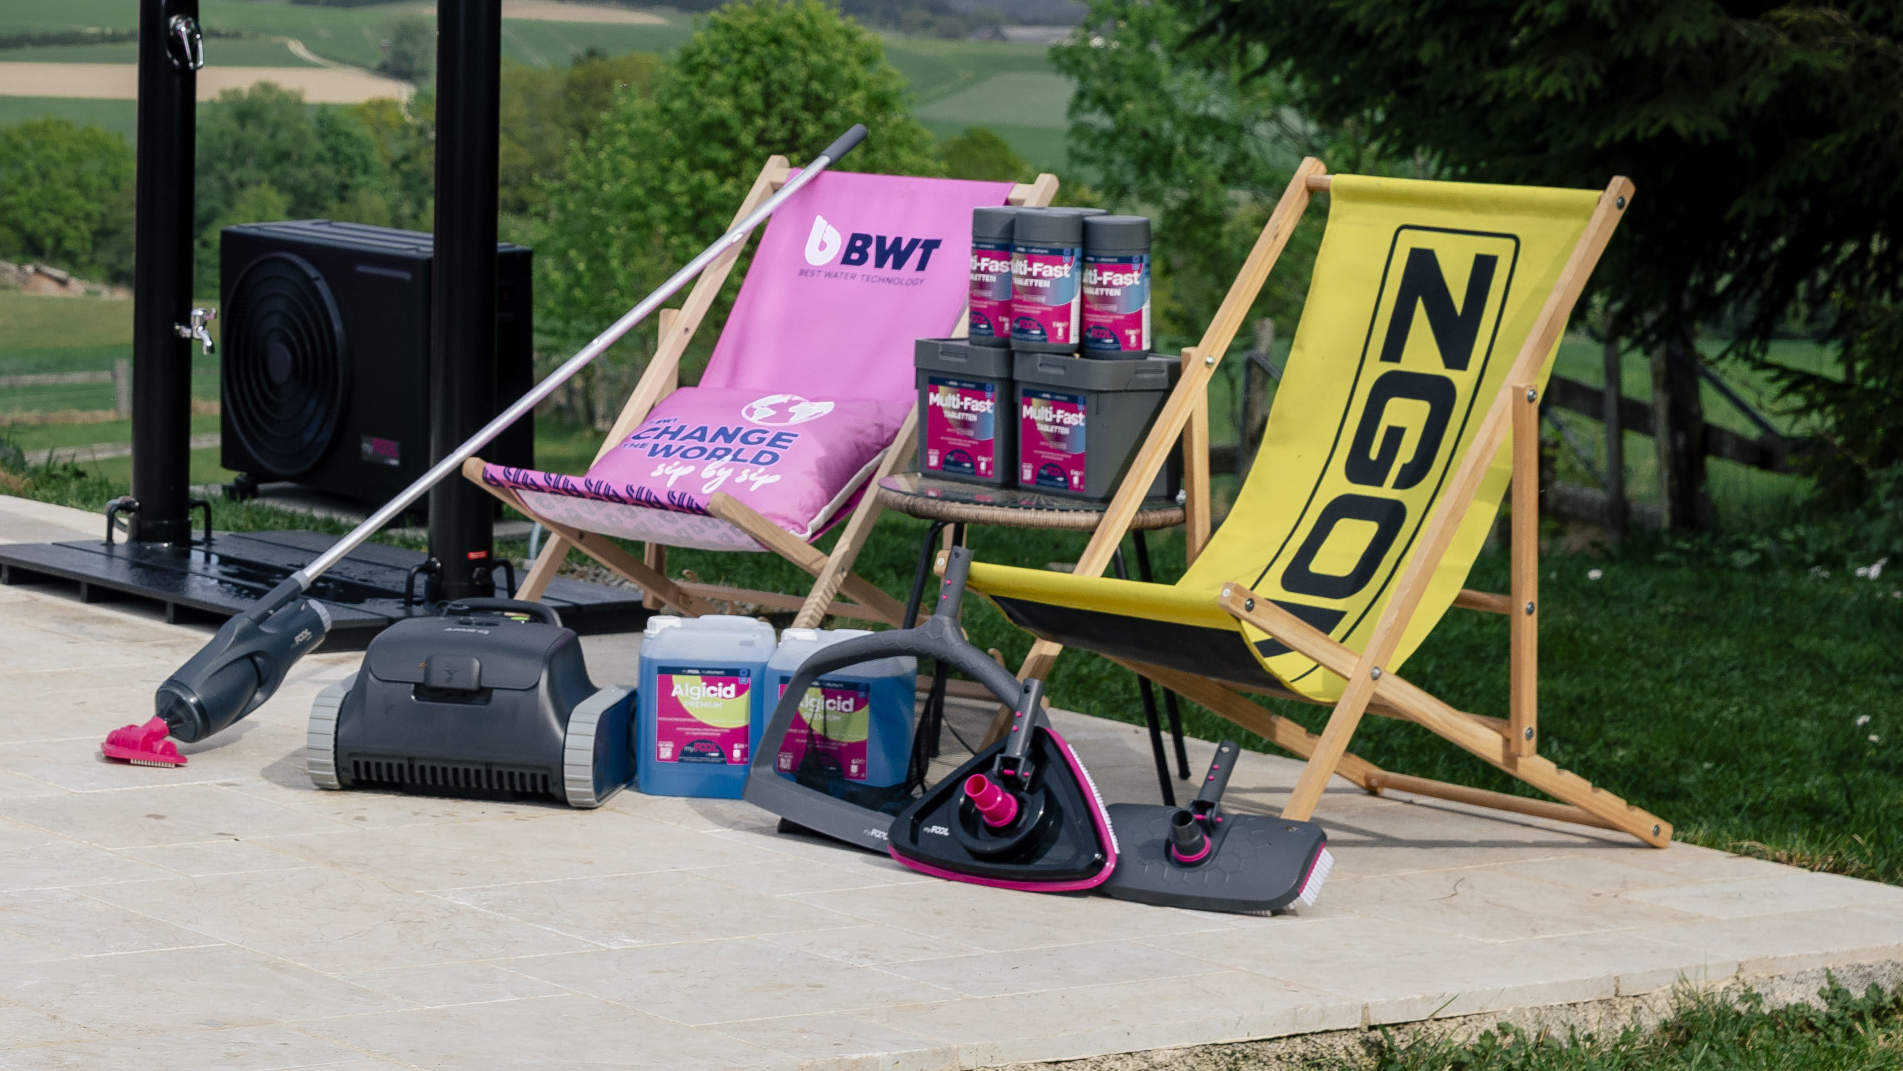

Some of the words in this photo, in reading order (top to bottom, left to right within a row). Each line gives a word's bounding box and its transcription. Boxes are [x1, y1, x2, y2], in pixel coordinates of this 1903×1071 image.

[840, 232, 943, 272] BWT
[929, 392, 994, 415] Multi-Fast
[1022, 405, 1086, 427] Multi-Fast
[632, 425, 800, 450] CHANGE
[647, 443, 781, 466] WORLD
[650, 461, 696, 488] sip
[701, 455, 734, 494] by
[734, 467, 782, 492] sip
[671, 682, 736, 700] Algicid
